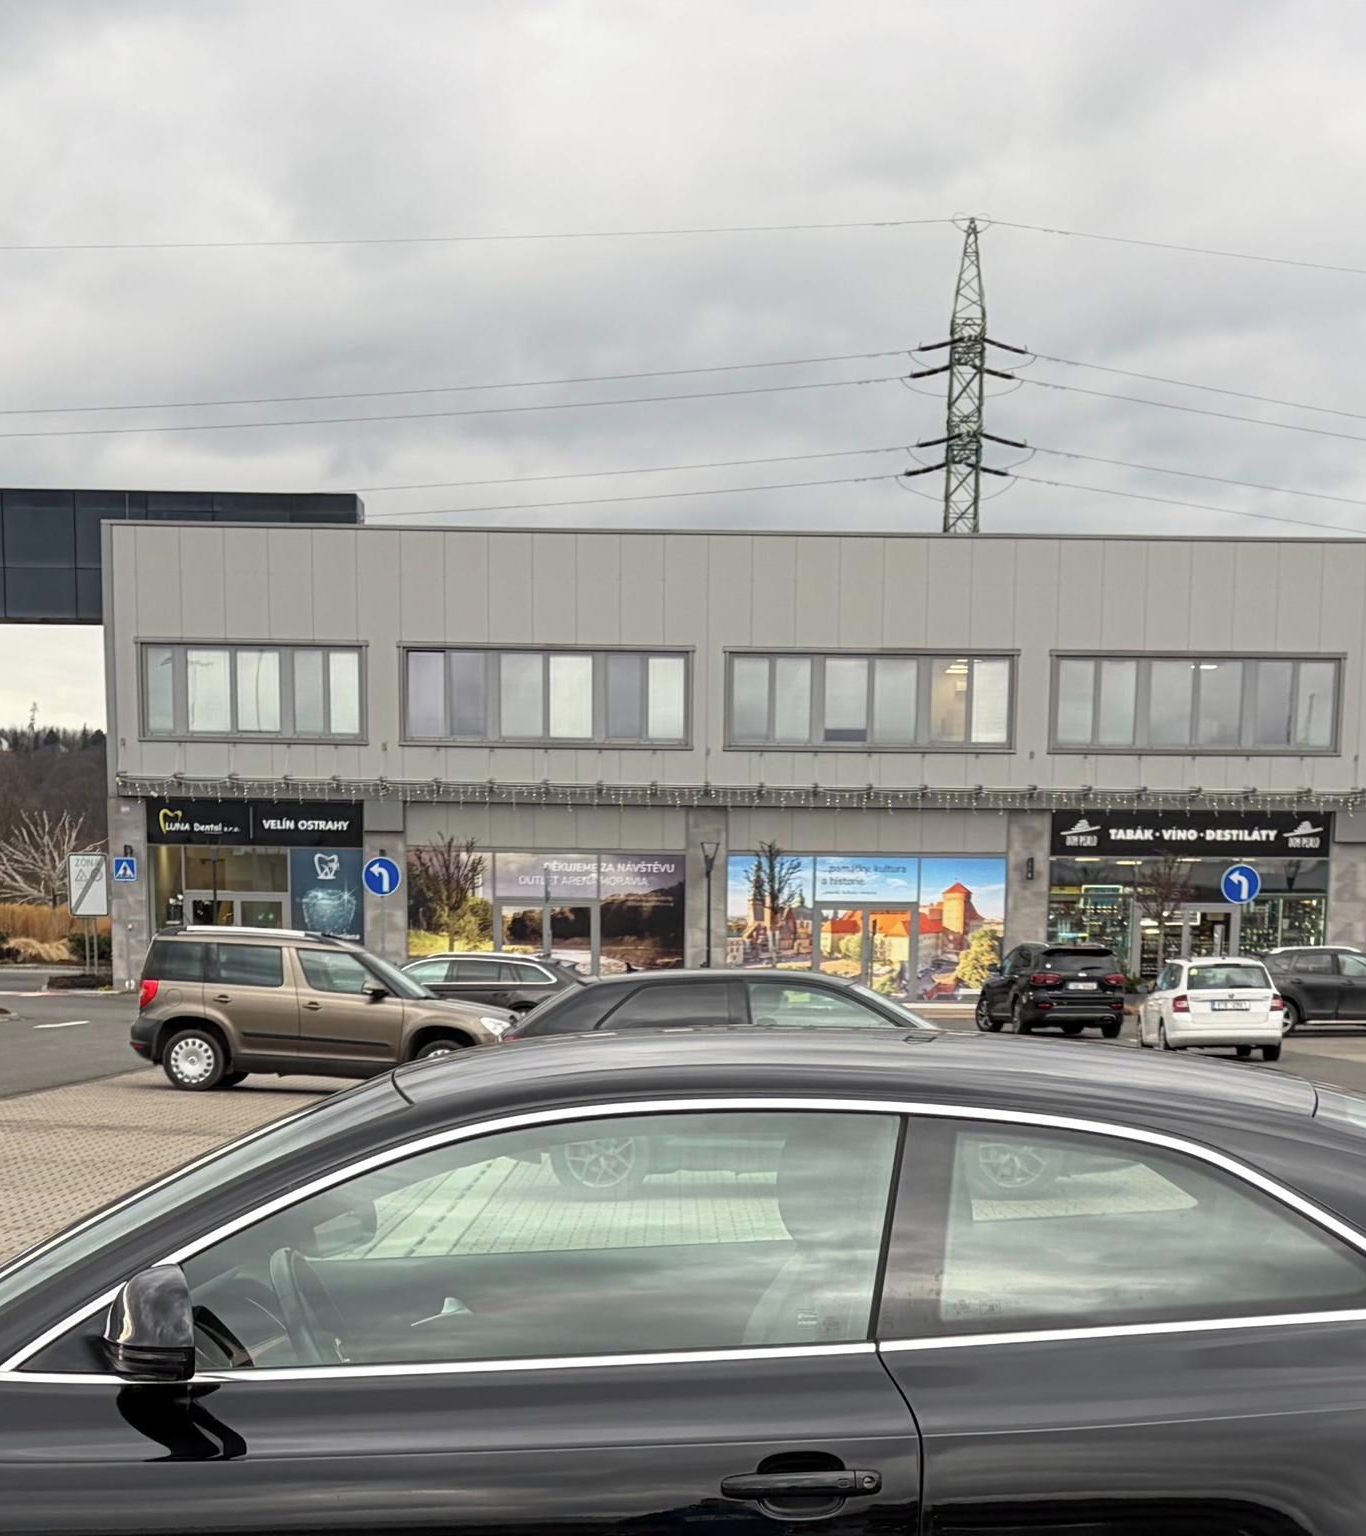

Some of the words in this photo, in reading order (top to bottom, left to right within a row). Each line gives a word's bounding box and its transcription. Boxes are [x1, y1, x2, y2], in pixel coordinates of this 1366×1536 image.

[193, 823, 222, 833] Dental
[262, 817, 295, 830] VELÍN
[297, 819, 350, 831] OSTRAHY
[1109, 827, 1154, 841] TABÁK
[1160, 826, 1198, 841] VÍNO
[1205, 826, 1278, 842] DESTILÁTY
[599, 863, 614, 873] ZA
[617, 861, 675, 873] NÁVŠTĚVU
